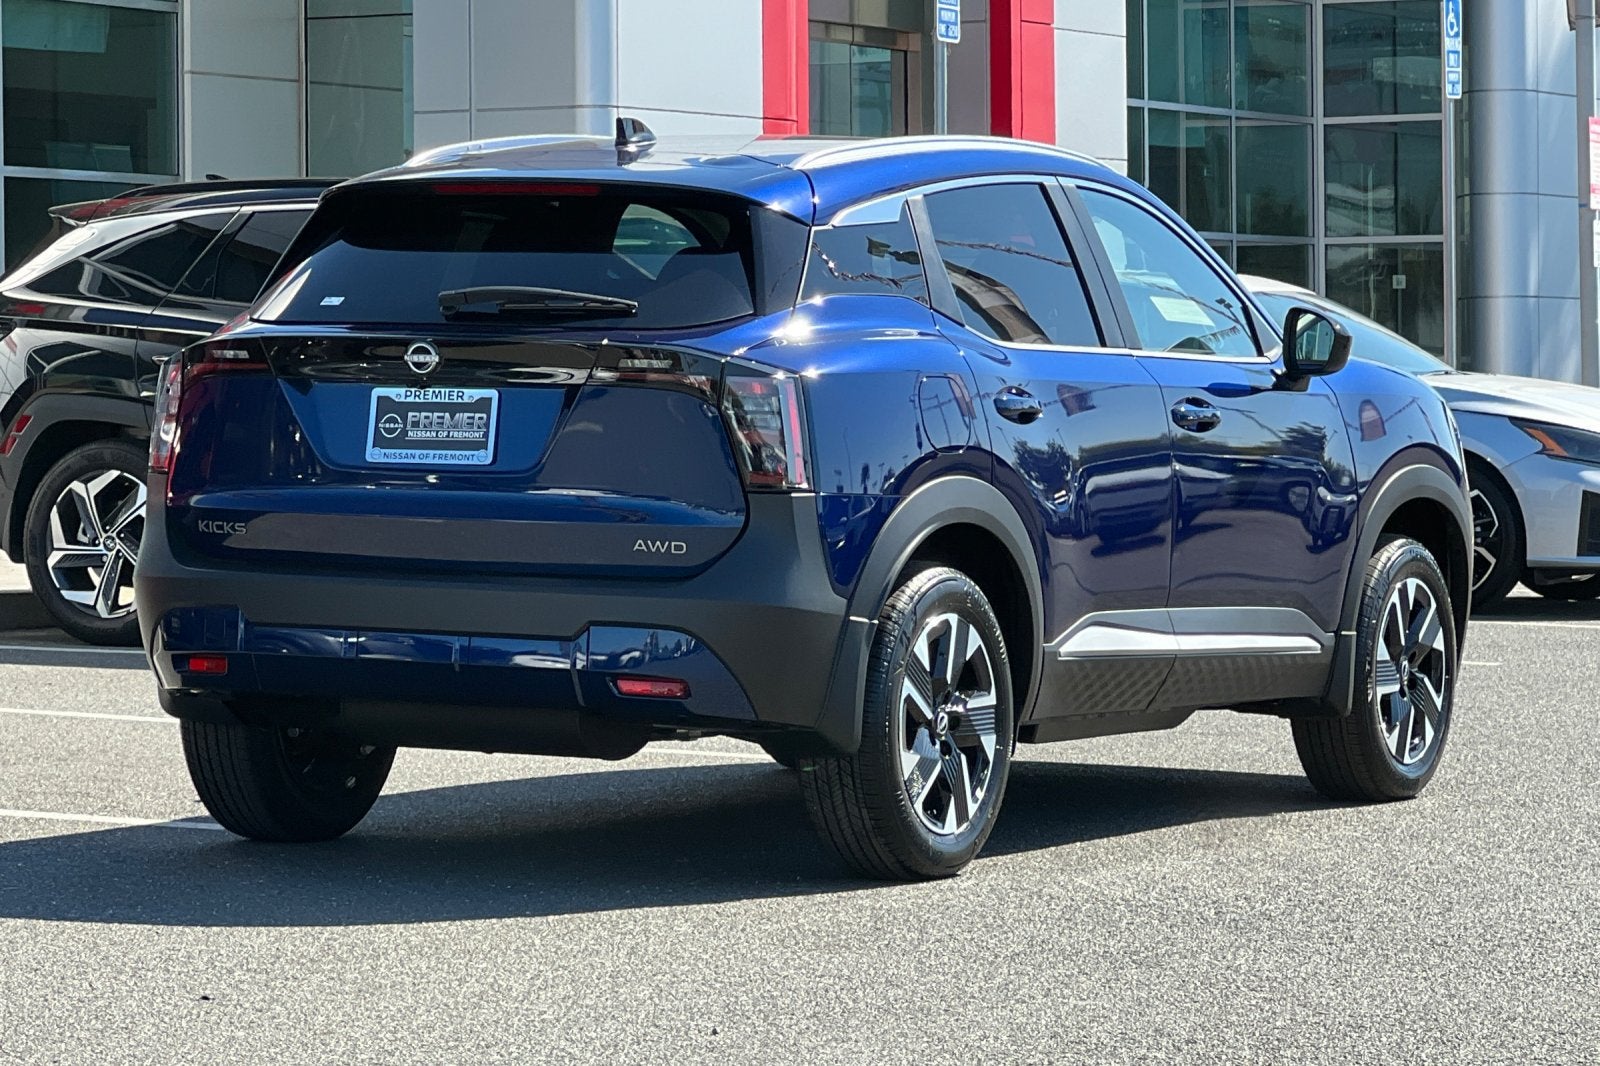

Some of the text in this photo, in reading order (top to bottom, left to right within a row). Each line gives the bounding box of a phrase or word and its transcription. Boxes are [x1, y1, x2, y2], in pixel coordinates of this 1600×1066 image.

[404, 354, 439, 363] NISSAN
[404, 389, 465, 401] PREMIER
[406, 411, 487, 430] PREMIER
[407, 430, 437, 438] NISSAN
[383, 452, 476, 461] NISSAN OF FREMONT
[198, 519, 247, 535] KICKS
[632, 539, 687, 554] AWD
